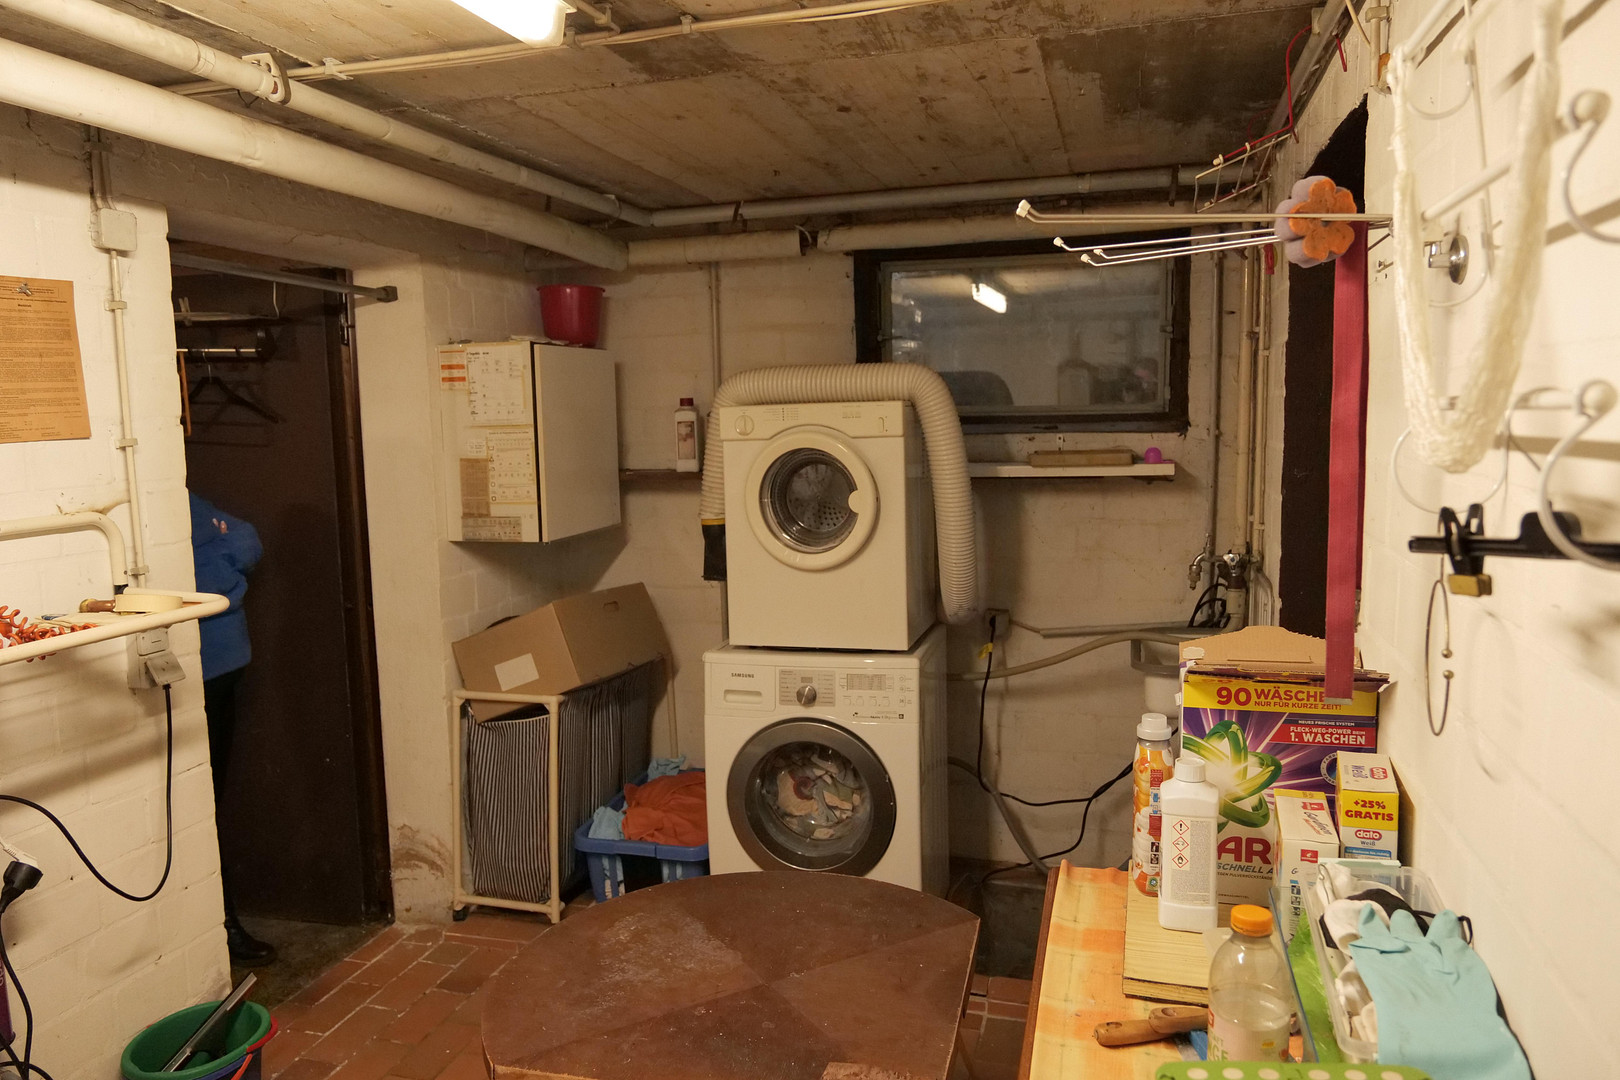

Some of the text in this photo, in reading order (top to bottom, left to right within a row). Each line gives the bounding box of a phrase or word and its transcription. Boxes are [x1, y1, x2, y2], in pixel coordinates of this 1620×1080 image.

[1216, 686, 1325, 707] 90 WÄSCHE
[1273, 700, 1289, 708] FÜR
[1291, 702, 1319, 710] KURZE
[1290, 732, 1366, 745] 1. WASCHEN
[1353, 799, 1386, 810] +25%
[1345, 809, 1394, 822] GRATIS
[1356, 830, 1380, 840] dato
[1217, 862, 1264, 874] SCHNELL
